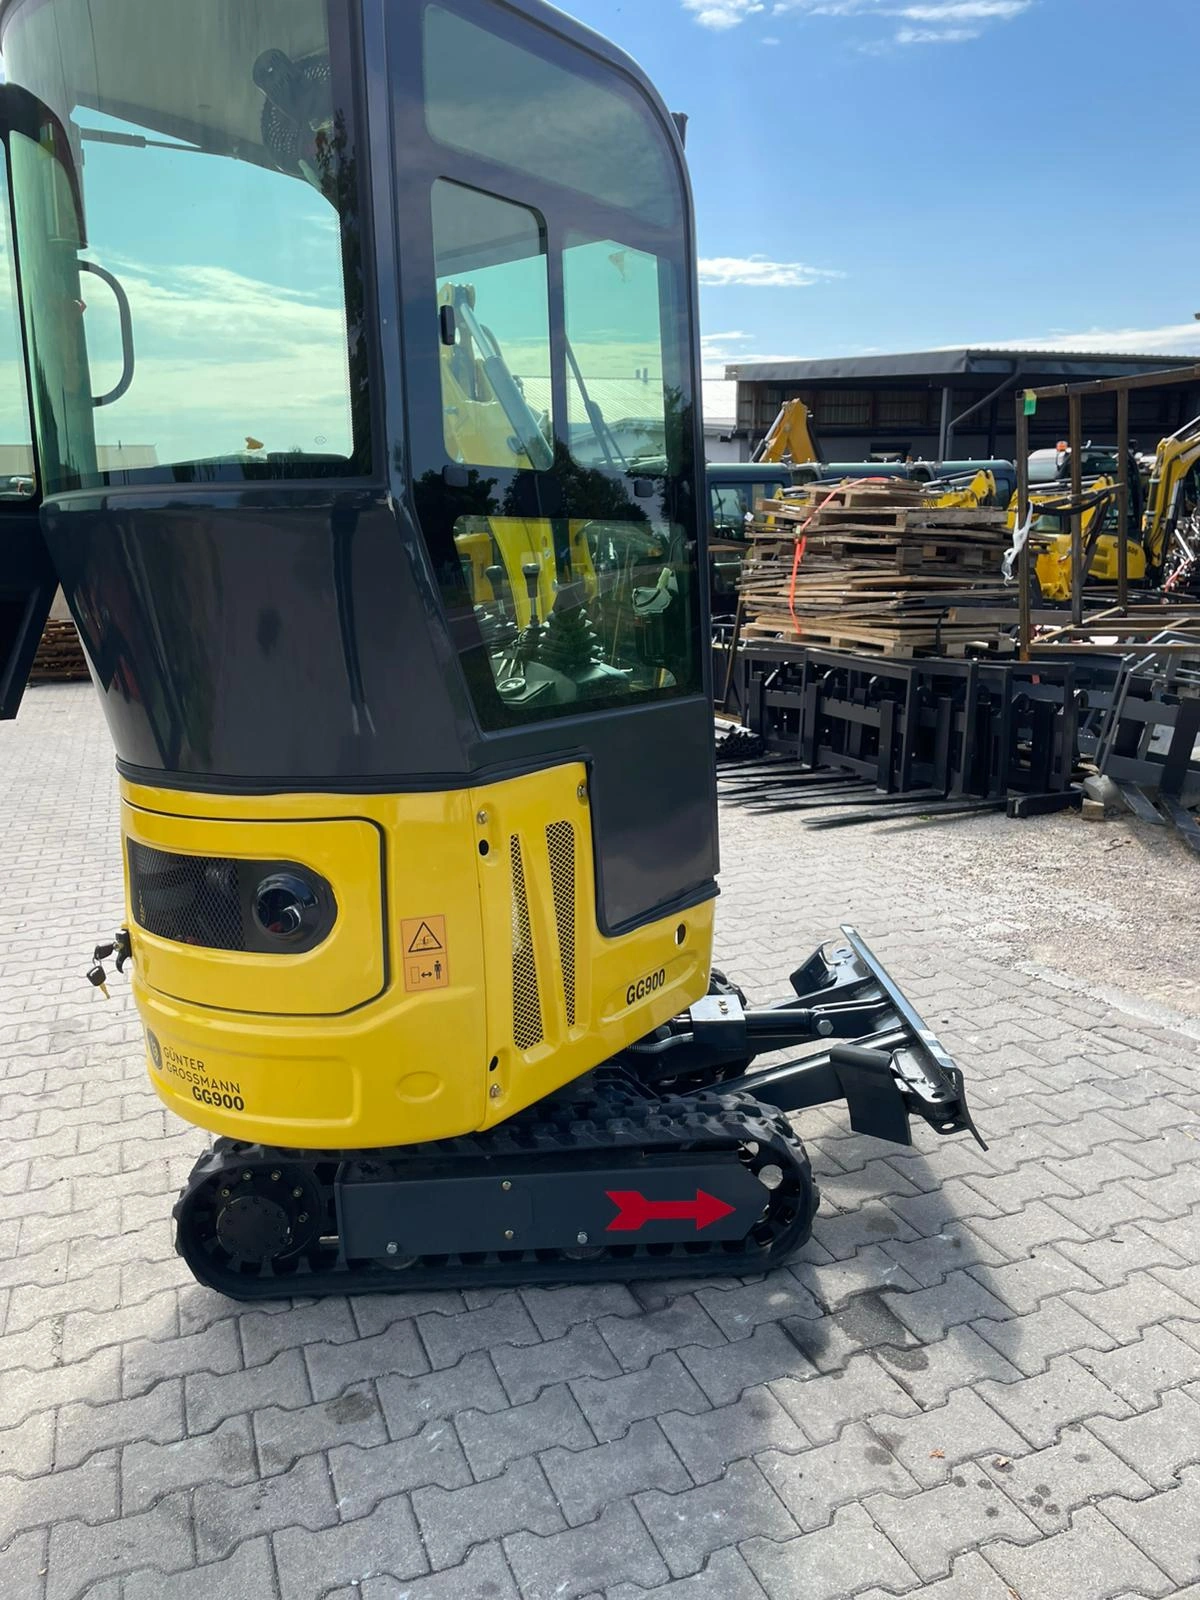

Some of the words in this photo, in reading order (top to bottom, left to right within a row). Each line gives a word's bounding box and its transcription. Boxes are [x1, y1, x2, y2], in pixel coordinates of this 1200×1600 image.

[626, 968, 666, 1006] GG900
[163, 1046, 206, 1073] GÜNTER
[166, 1061, 241, 1094] GROSSMANN
[192, 1085, 245, 1111] GG900
